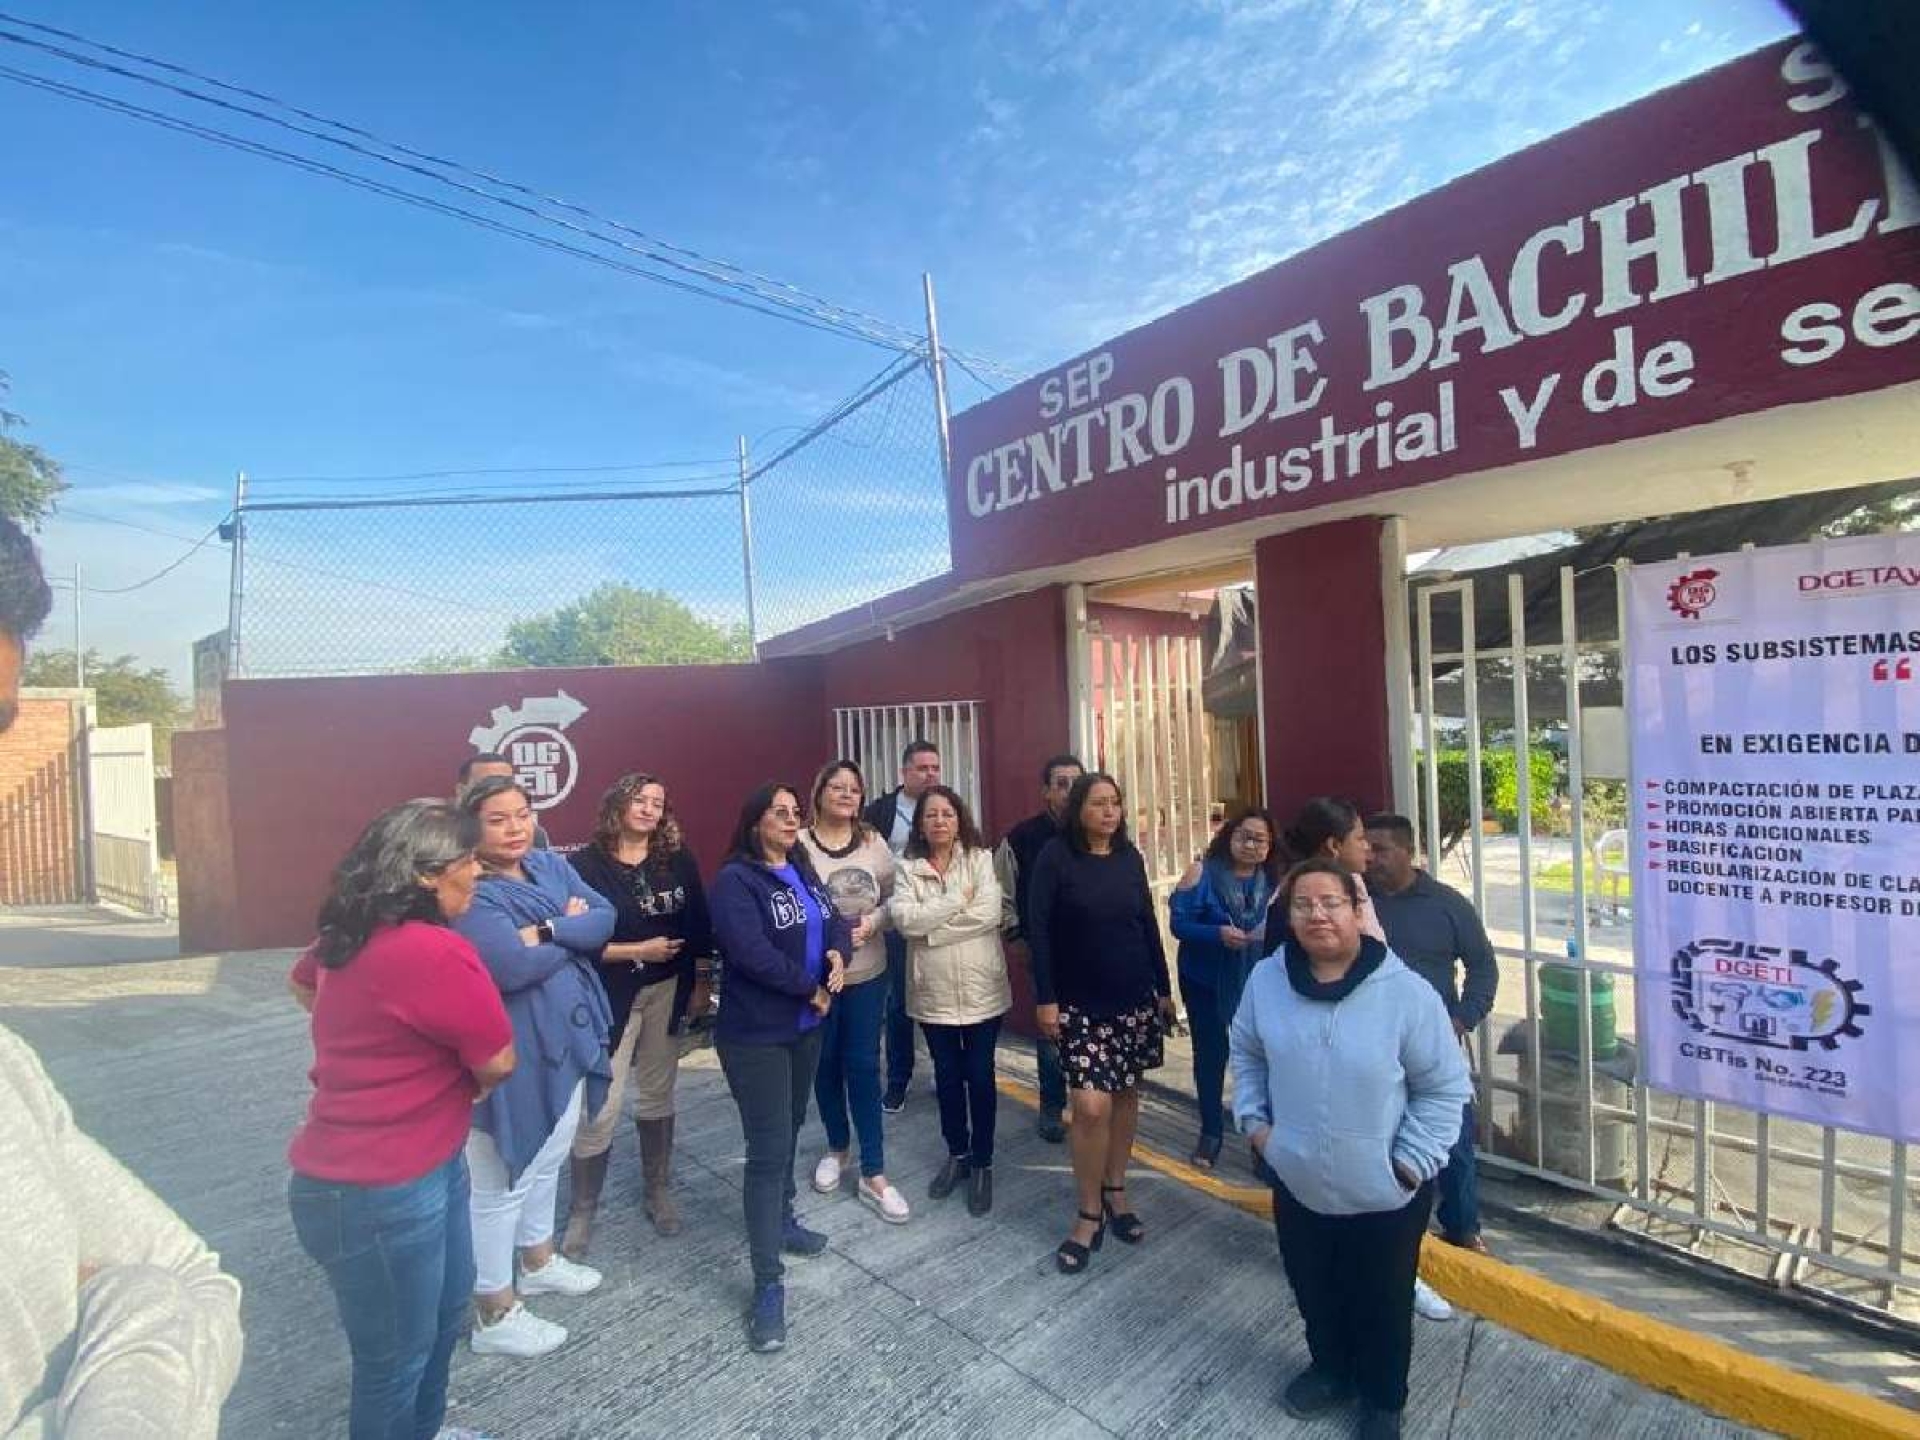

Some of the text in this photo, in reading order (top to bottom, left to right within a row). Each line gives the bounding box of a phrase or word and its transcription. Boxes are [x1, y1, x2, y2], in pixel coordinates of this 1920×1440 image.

[1039, 352, 1115, 418] SEP
[967, 376, 1195, 517] CENTRO
[1217, 319, 1328, 437] DE
[1165, 382, 1456, 524] industrial
[1582, 326, 1695, 412] de
[1671, 631, 1920, 665] LOS SUBSISTEMAS
[1700, 734, 1732, 755] EN
[1743, 733, 1891, 754] EXIGENCIA
[1664, 779, 1920, 800] COMPACTACIÓN DE PLAZ
[1665, 800, 1782, 819] PROMOCIÓN
[1789, 804, 1879, 822] ABIERTA
[1665, 820, 1871, 844] HORAS ADICIONALES
[1667, 860, 1836, 886] REGULARIZACIÓN
[1844, 873, 1873, 889] DE
[1668, 880, 1753, 900] DOCENTE
[1760, 887, 1773, 904] A
[1780, 890, 1892, 915] PROFESOR
[1714, 958, 1792, 983] DGETI
[1679, 1042, 1748, 1068] CBTis
[1755, 1057, 1795, 1077] No.
[1802, 1066, 1846, 1088] 223
